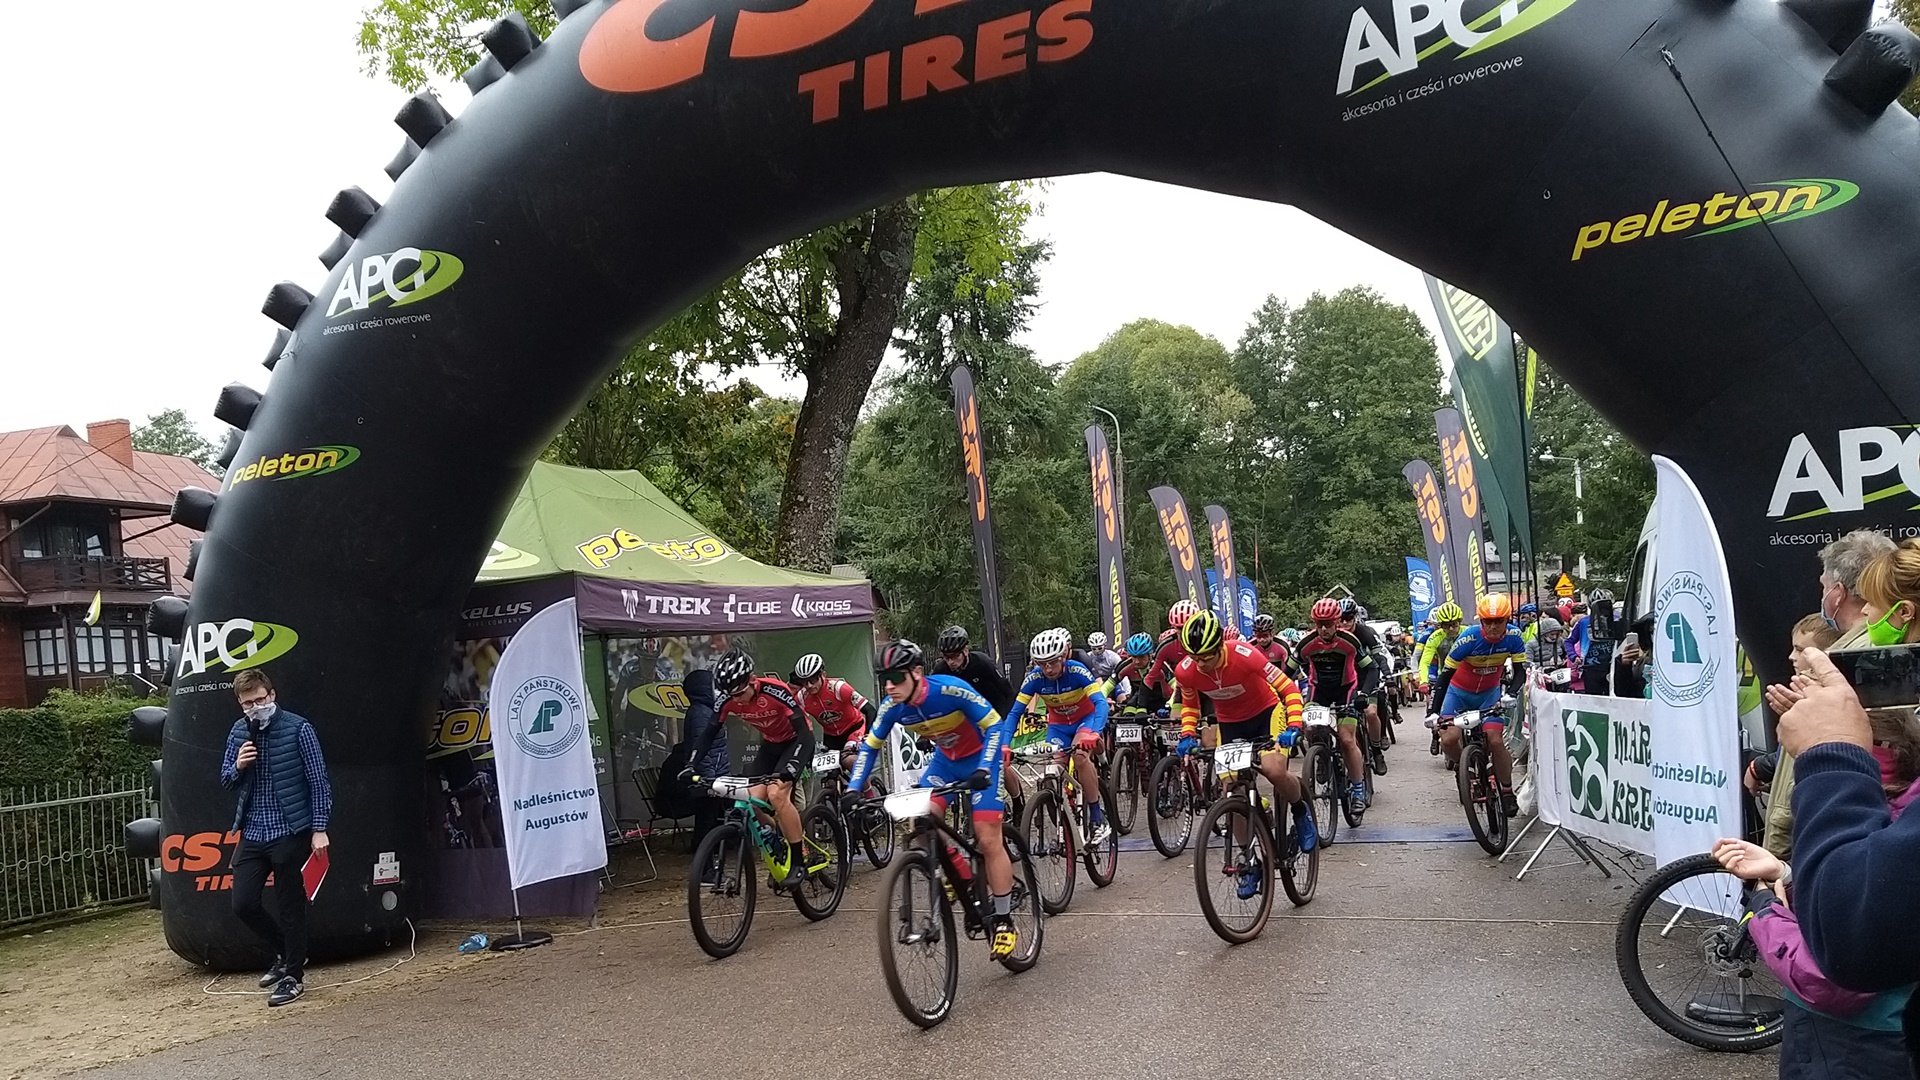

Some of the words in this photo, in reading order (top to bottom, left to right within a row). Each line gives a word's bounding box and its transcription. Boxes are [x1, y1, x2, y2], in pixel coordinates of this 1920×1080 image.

[797, 0, 1094, 124] TIRES
[1341, 94, 1397, 122] akcesoria
[1399, 90, 1404, 103] i
[1406, 75, 1445, 101] części
[1448, 55, 1524, 88] rowerowe
[1571, 182, 1824, 262] peleton
[322, 321, 355, 336] akcesoria
[385, 312, 432, 326] rowerowe
[228, 449, 339, 492] peleton
[1769, 530, 1833, 546] akcesoria
[645, 595, 711, 615] TREK
[737, 600, 781, 615] CUBE
[806, 599, 852, 612] KROSS
[488, 617, 523, 627] COMPANY
[511, 692, 525, 720] LASY
[524, 679, 580, 712] PAŃSTWOWE
[1307, 711, 1323, 722] 804
[1463, 716, 1470, 726] 5
[1120, 729, 1139, 738] 2337
[816, 754, 836, 767] 2795
[513, 786, 595, 812] Nadleśnictwo
[525, 810, 589, 831] Augustów
